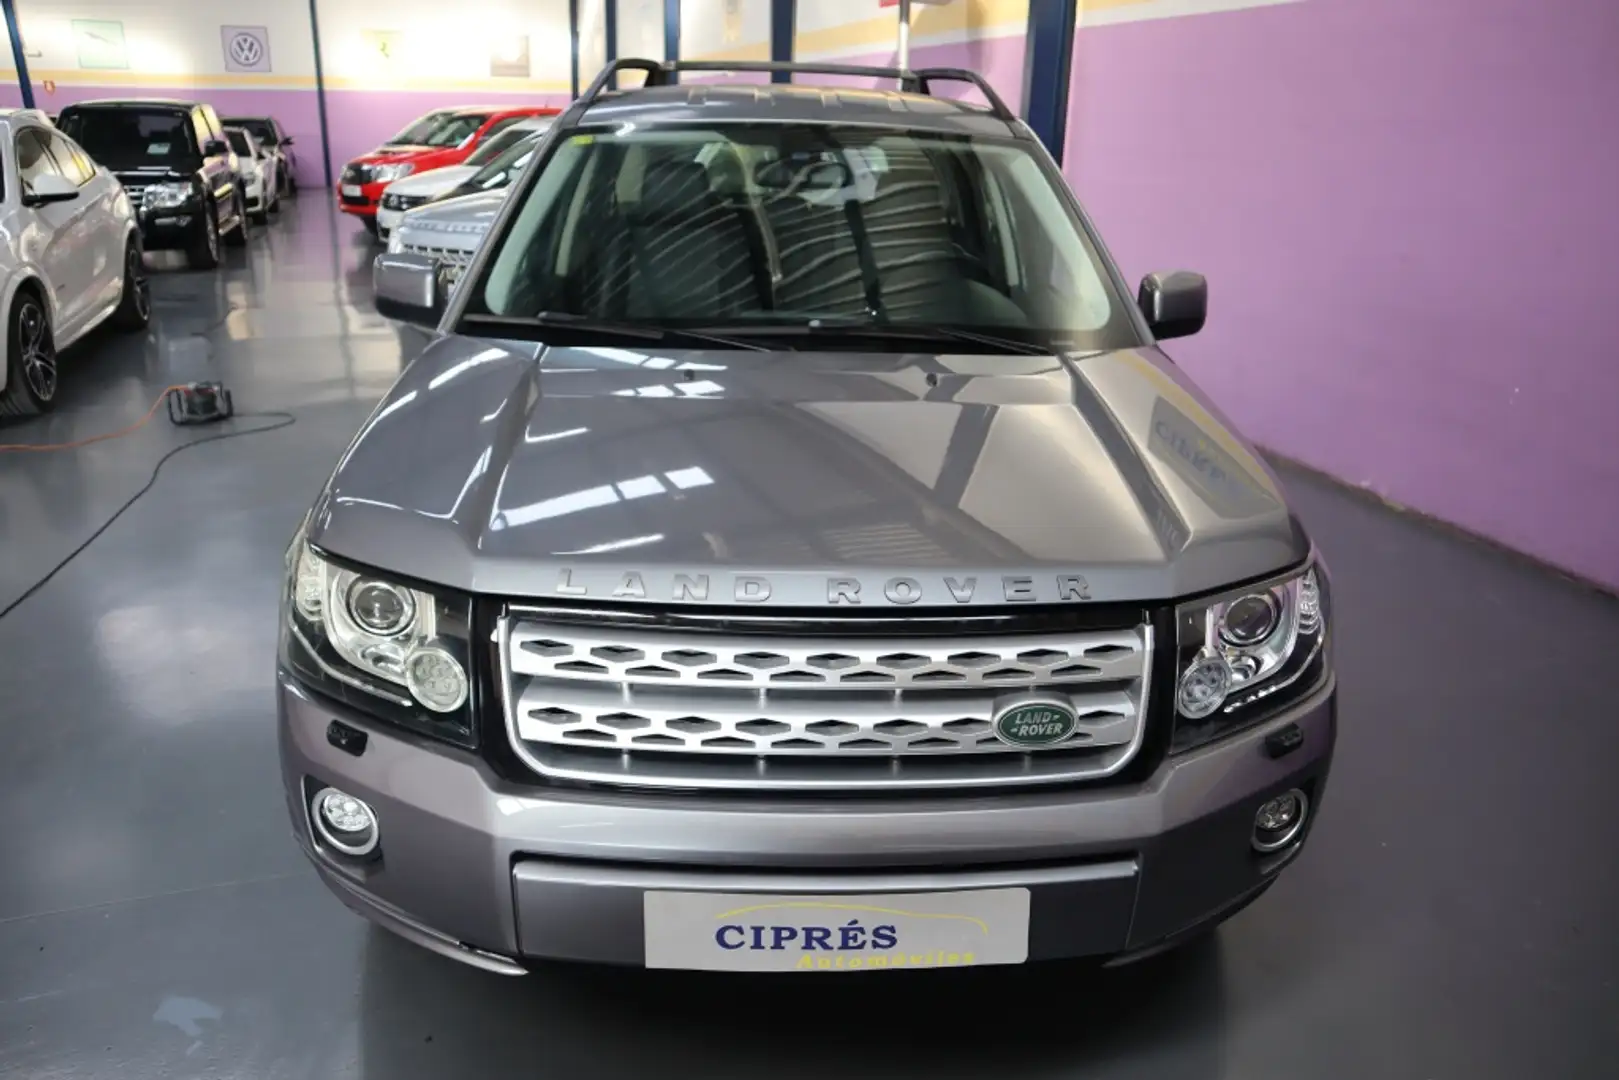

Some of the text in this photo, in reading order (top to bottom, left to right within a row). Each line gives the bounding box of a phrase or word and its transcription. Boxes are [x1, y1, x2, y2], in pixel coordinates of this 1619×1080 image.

[556, 568, 1092, 605] LAND ROVER
[715, 919, 898, 950] CIPRÉS
